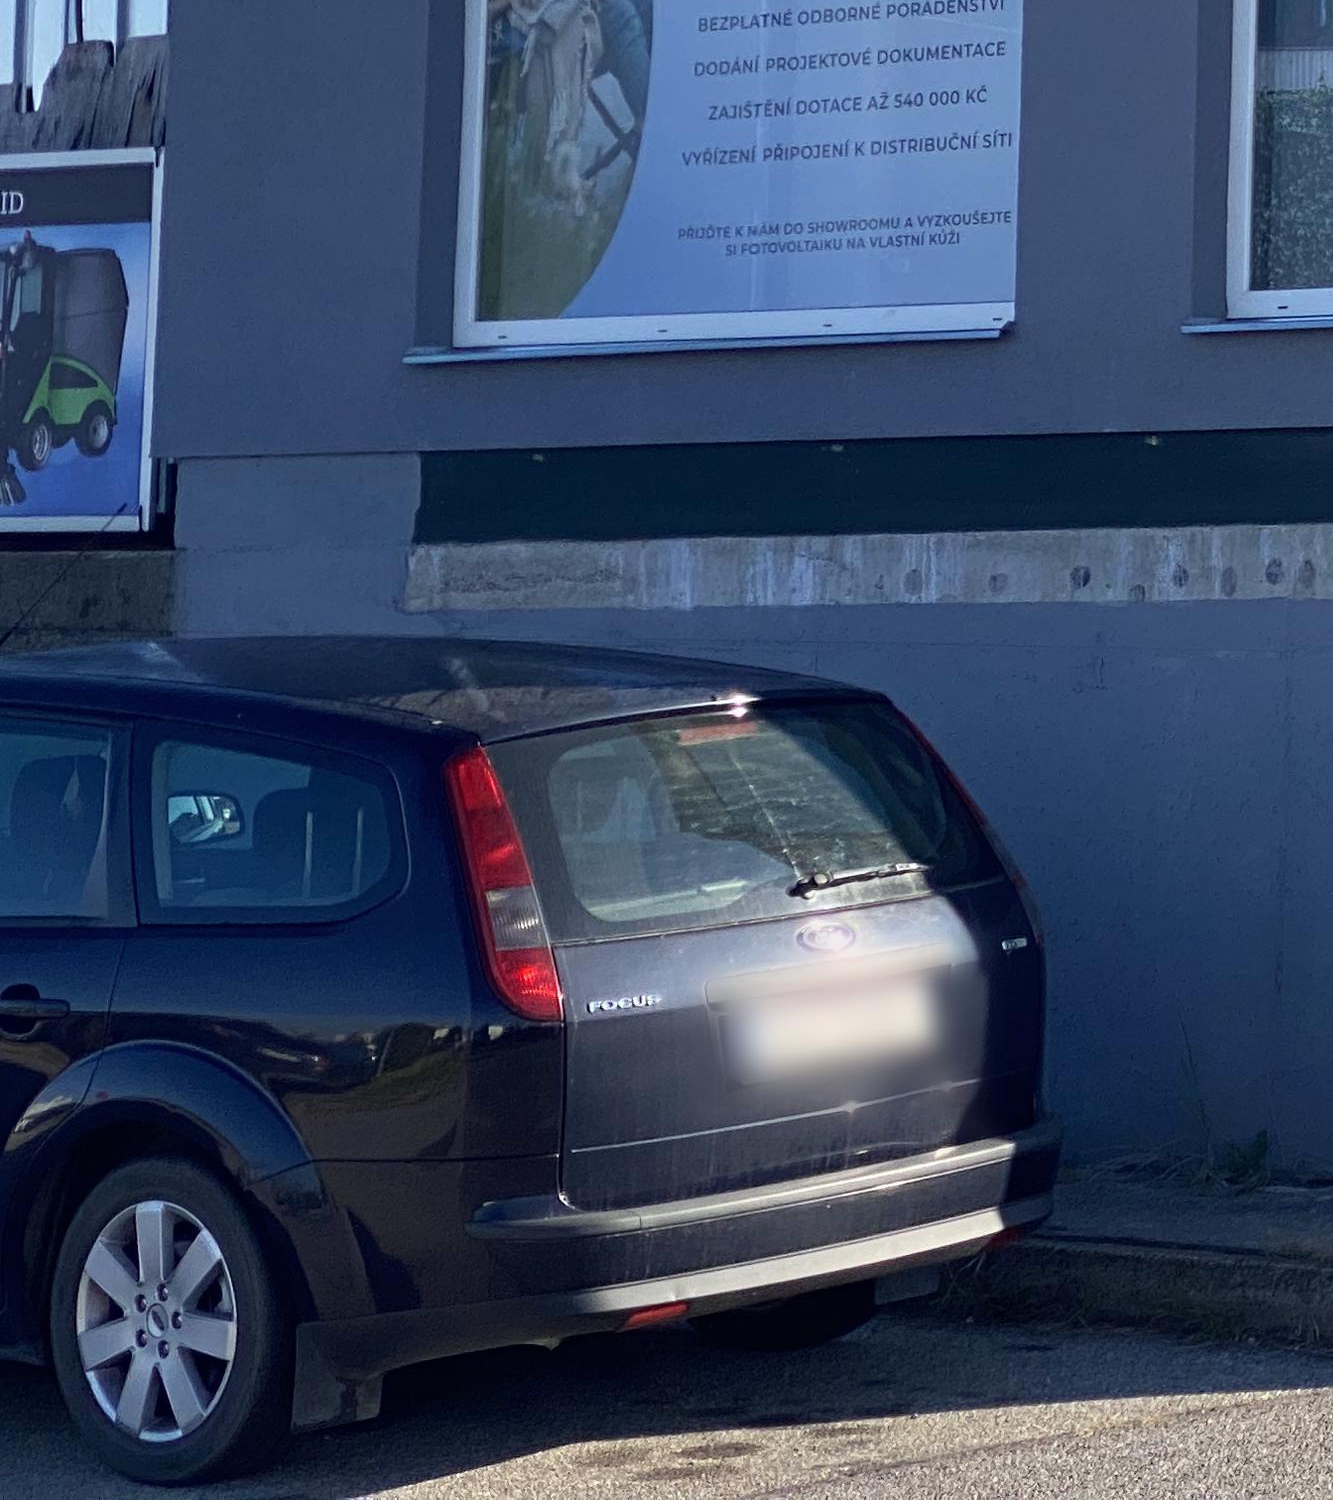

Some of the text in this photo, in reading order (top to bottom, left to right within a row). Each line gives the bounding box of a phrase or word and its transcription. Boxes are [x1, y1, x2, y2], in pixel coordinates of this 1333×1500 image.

[698, 8, 792, 32] BEZPLATNÉ
[797, 2, 881, 25] ODBORNÉ
[694, 40, 1007, 77] DODÁNÍ PROJEKTOVÉ DOKUMENTACE
[708, 85, 988, 121] ZAJIŠTĚNÍ DOTACE AŽ 540 000 KČ
[681, 128, 1013, 166] VYŘÍZENÍ PŘIPOJENÍ K DISTRIBUČNÍ SÍTI
[0, 191, 24, 215] ID
[735, 226, 743, 237] K
[747, 221, 779, 237] NÁM
[783, 222, 803, 235] DO
[807, 217, 900, 234] SHOWROOMU
[904, 217, 913, 228] A
[917, 210, 1012, 227] VYZKOUŠEJTE
[846, 237, 866, 250] NA
[869, 231, 925, 248] VLASTNÍ
